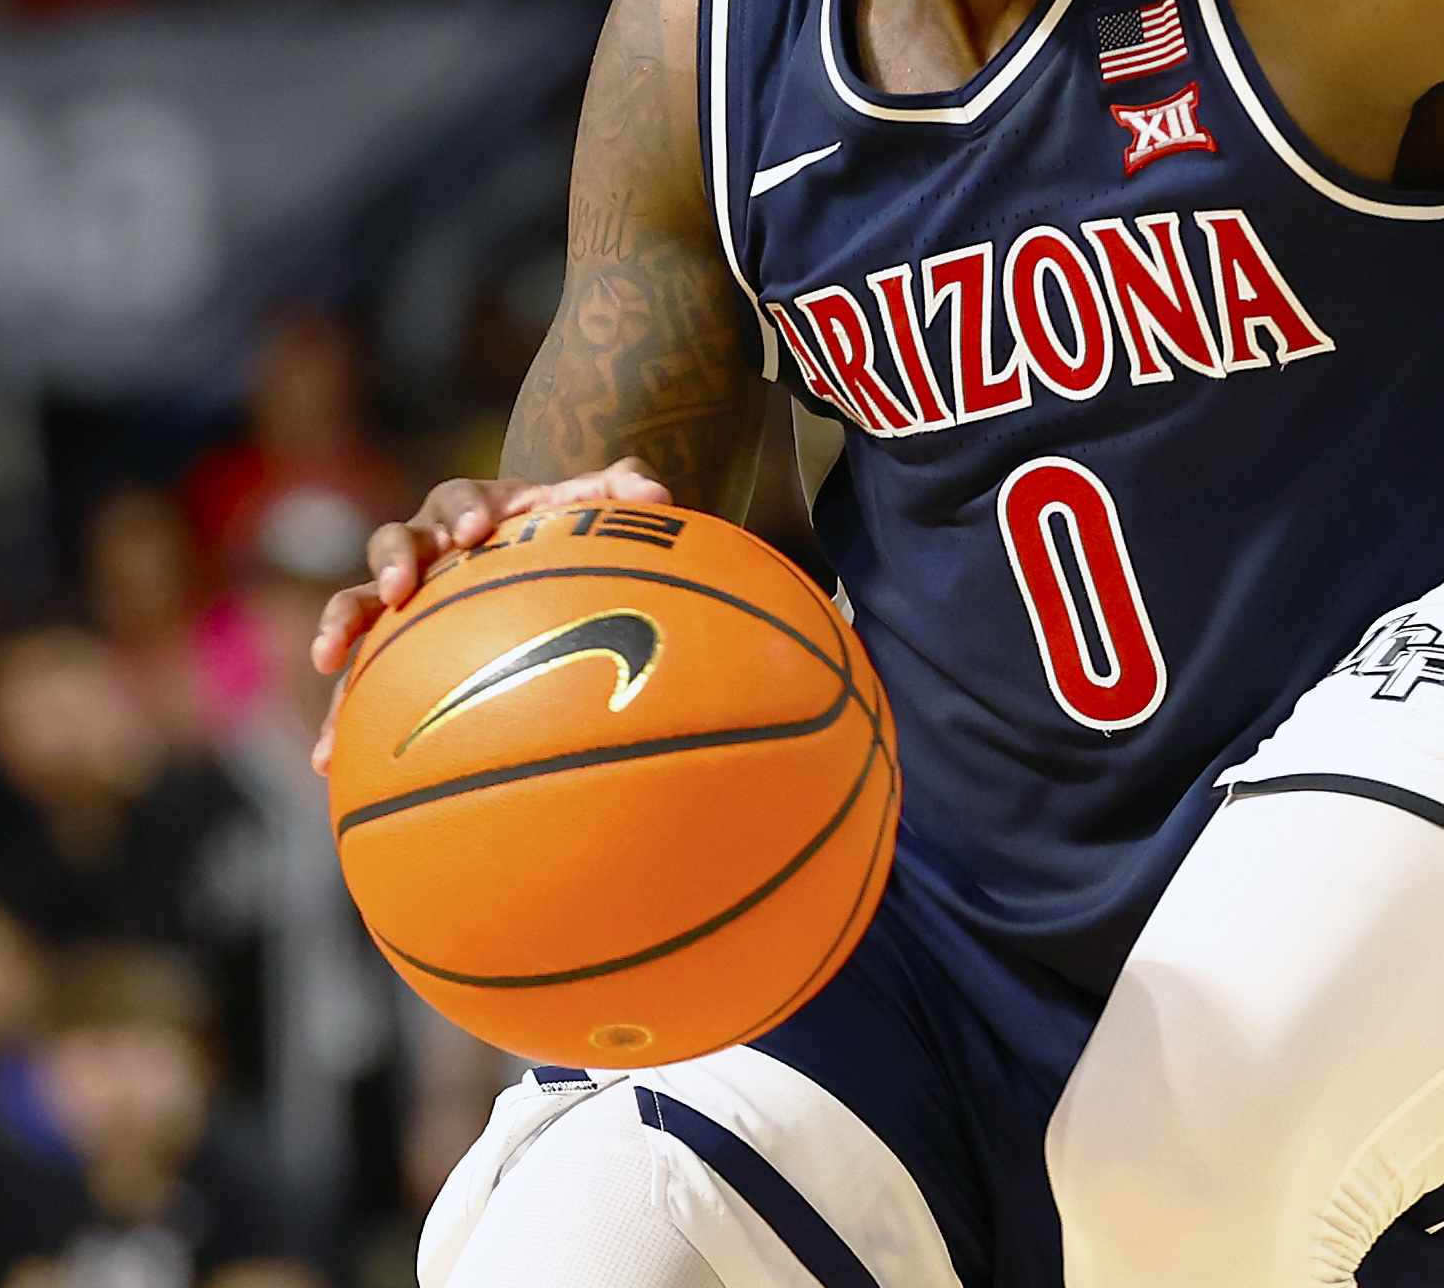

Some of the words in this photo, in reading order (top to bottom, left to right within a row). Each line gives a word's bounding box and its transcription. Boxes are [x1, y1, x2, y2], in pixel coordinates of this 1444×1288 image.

[1117, 89, 1209, 164] XII
[765, 208, 1337, 440] ARIZONA
[996, 455, 1168, 734] 0
